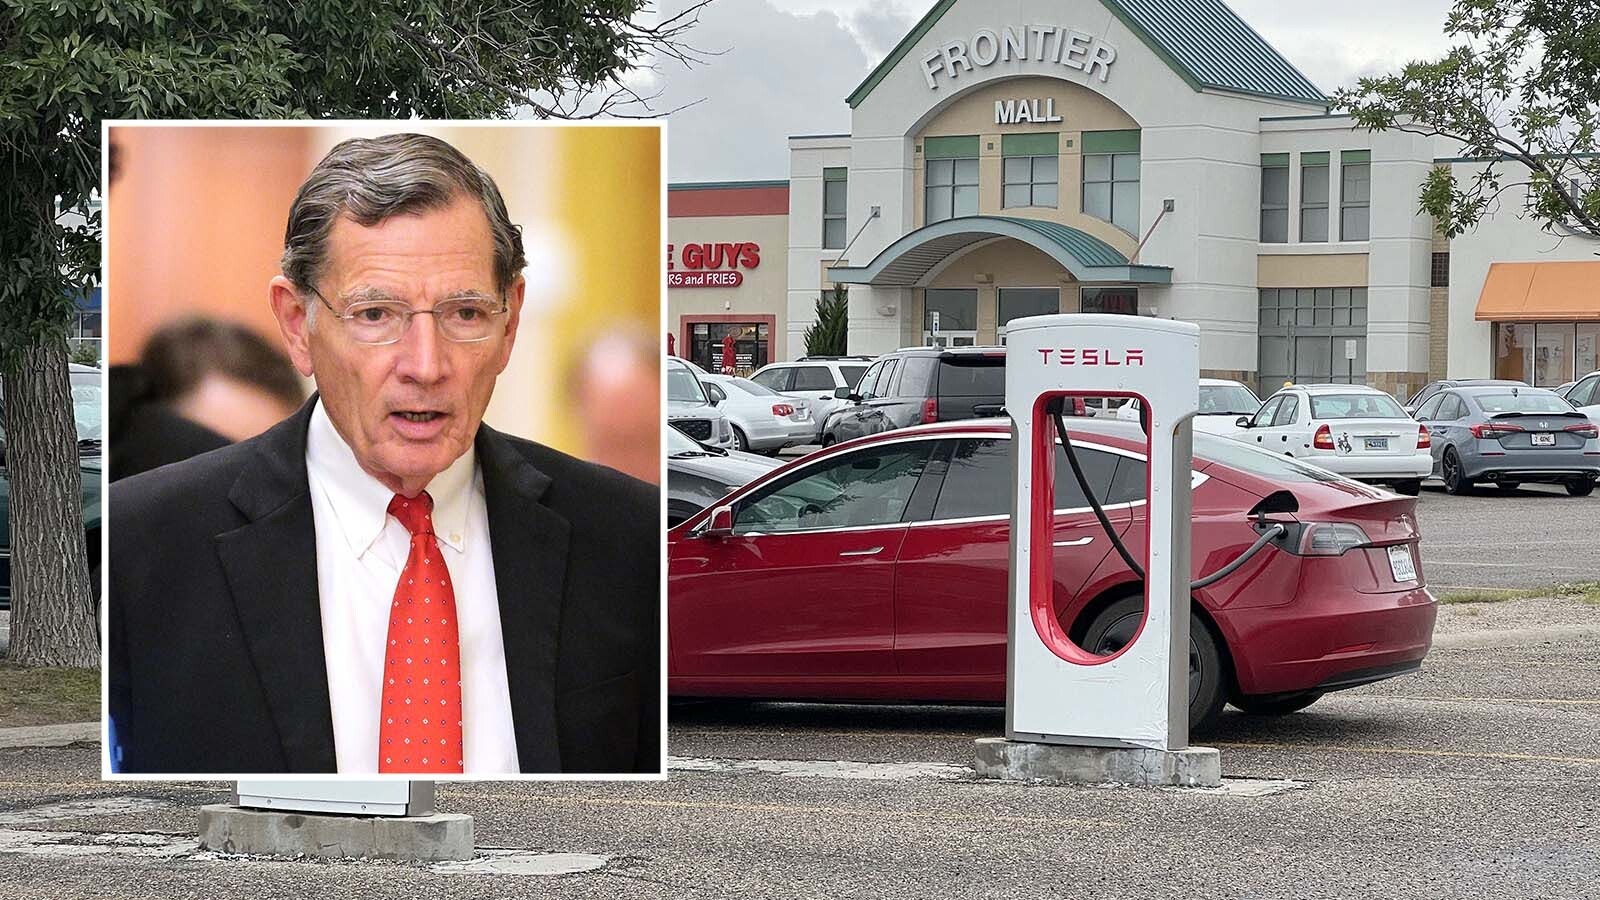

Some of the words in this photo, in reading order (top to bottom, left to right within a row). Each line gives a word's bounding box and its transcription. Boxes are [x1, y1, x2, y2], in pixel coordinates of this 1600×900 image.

[920, 24, 1118, 90] FRONTIER
[995, 98, 1063, 124] MALL
[682, 242, 761, 270] GUYS
[685, 273, 704, 285] and
[706, 273, 737, 285] FRIES
[1037, 349, 1144, 366] TESLA
